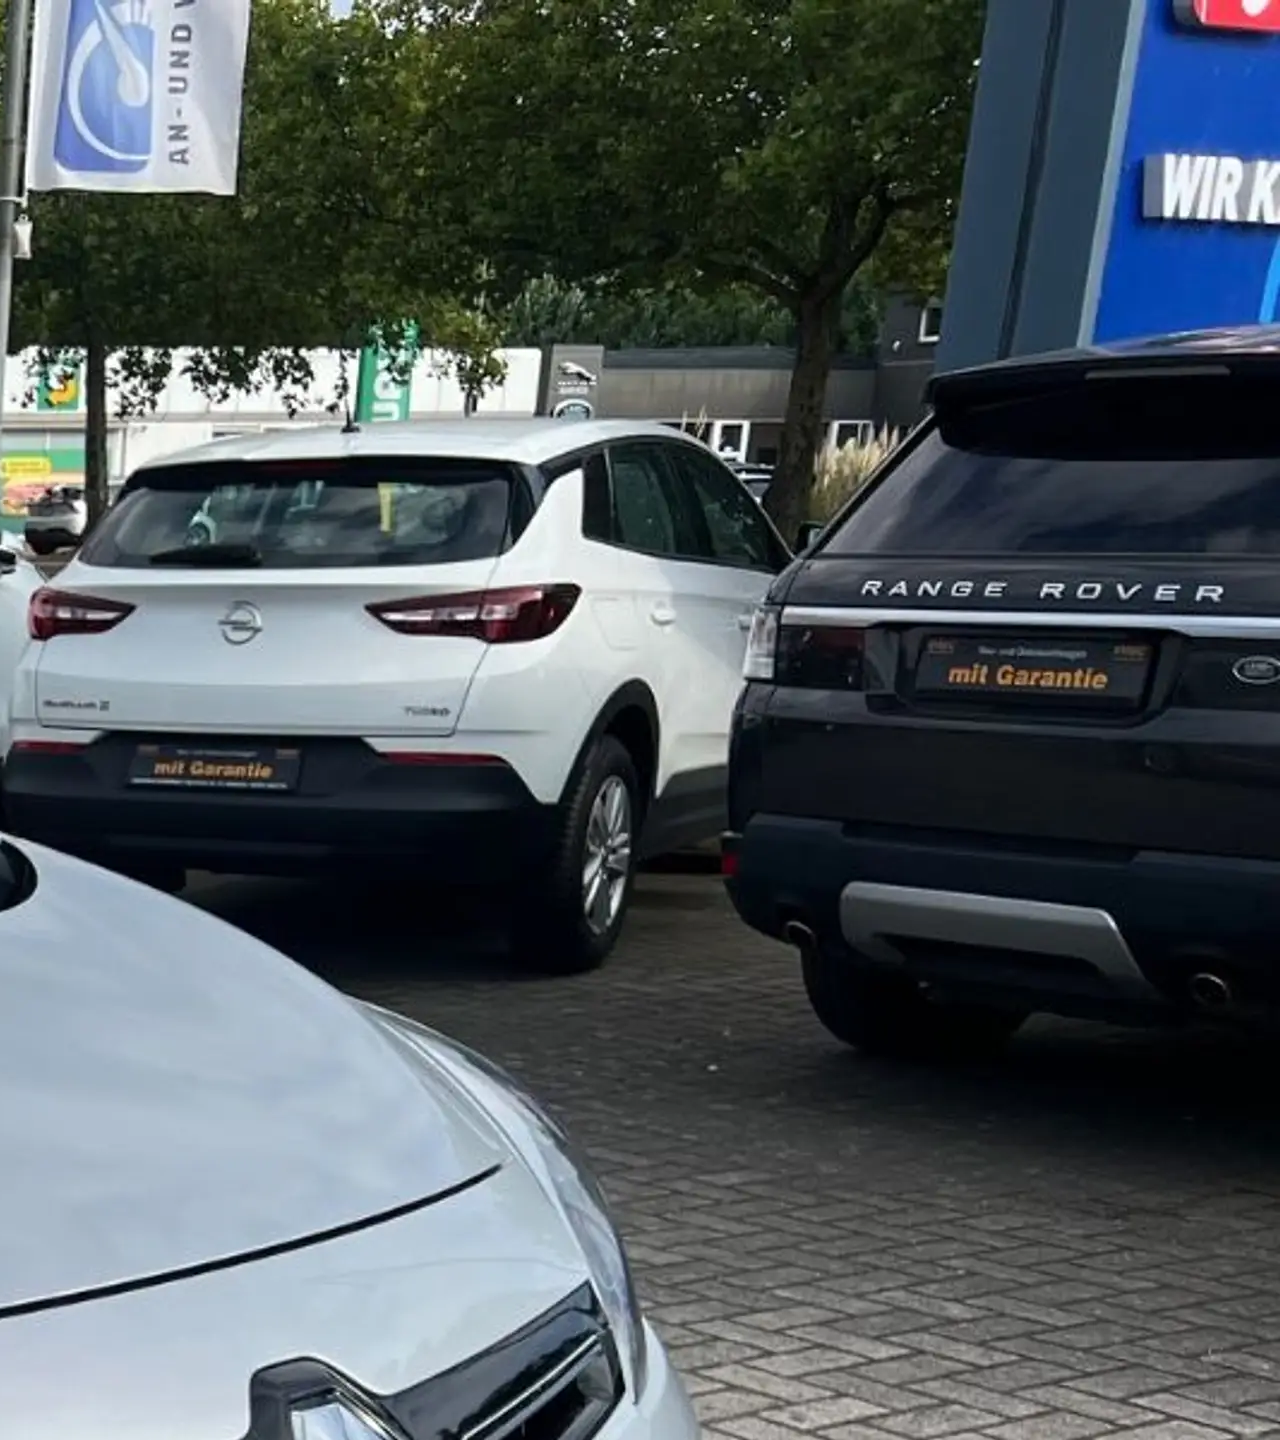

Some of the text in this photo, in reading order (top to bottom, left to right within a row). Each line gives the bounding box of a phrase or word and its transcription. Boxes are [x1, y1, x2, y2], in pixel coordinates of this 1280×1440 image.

[168, 24, 193, 94] UND
[1161, 153, 1243, 221] WIR
[860, 579, 1224, 603] RANGE ROVER
[948, 664, 1109, 690] mit Garantie
[153, 760, 274, 778] mit Garantie
